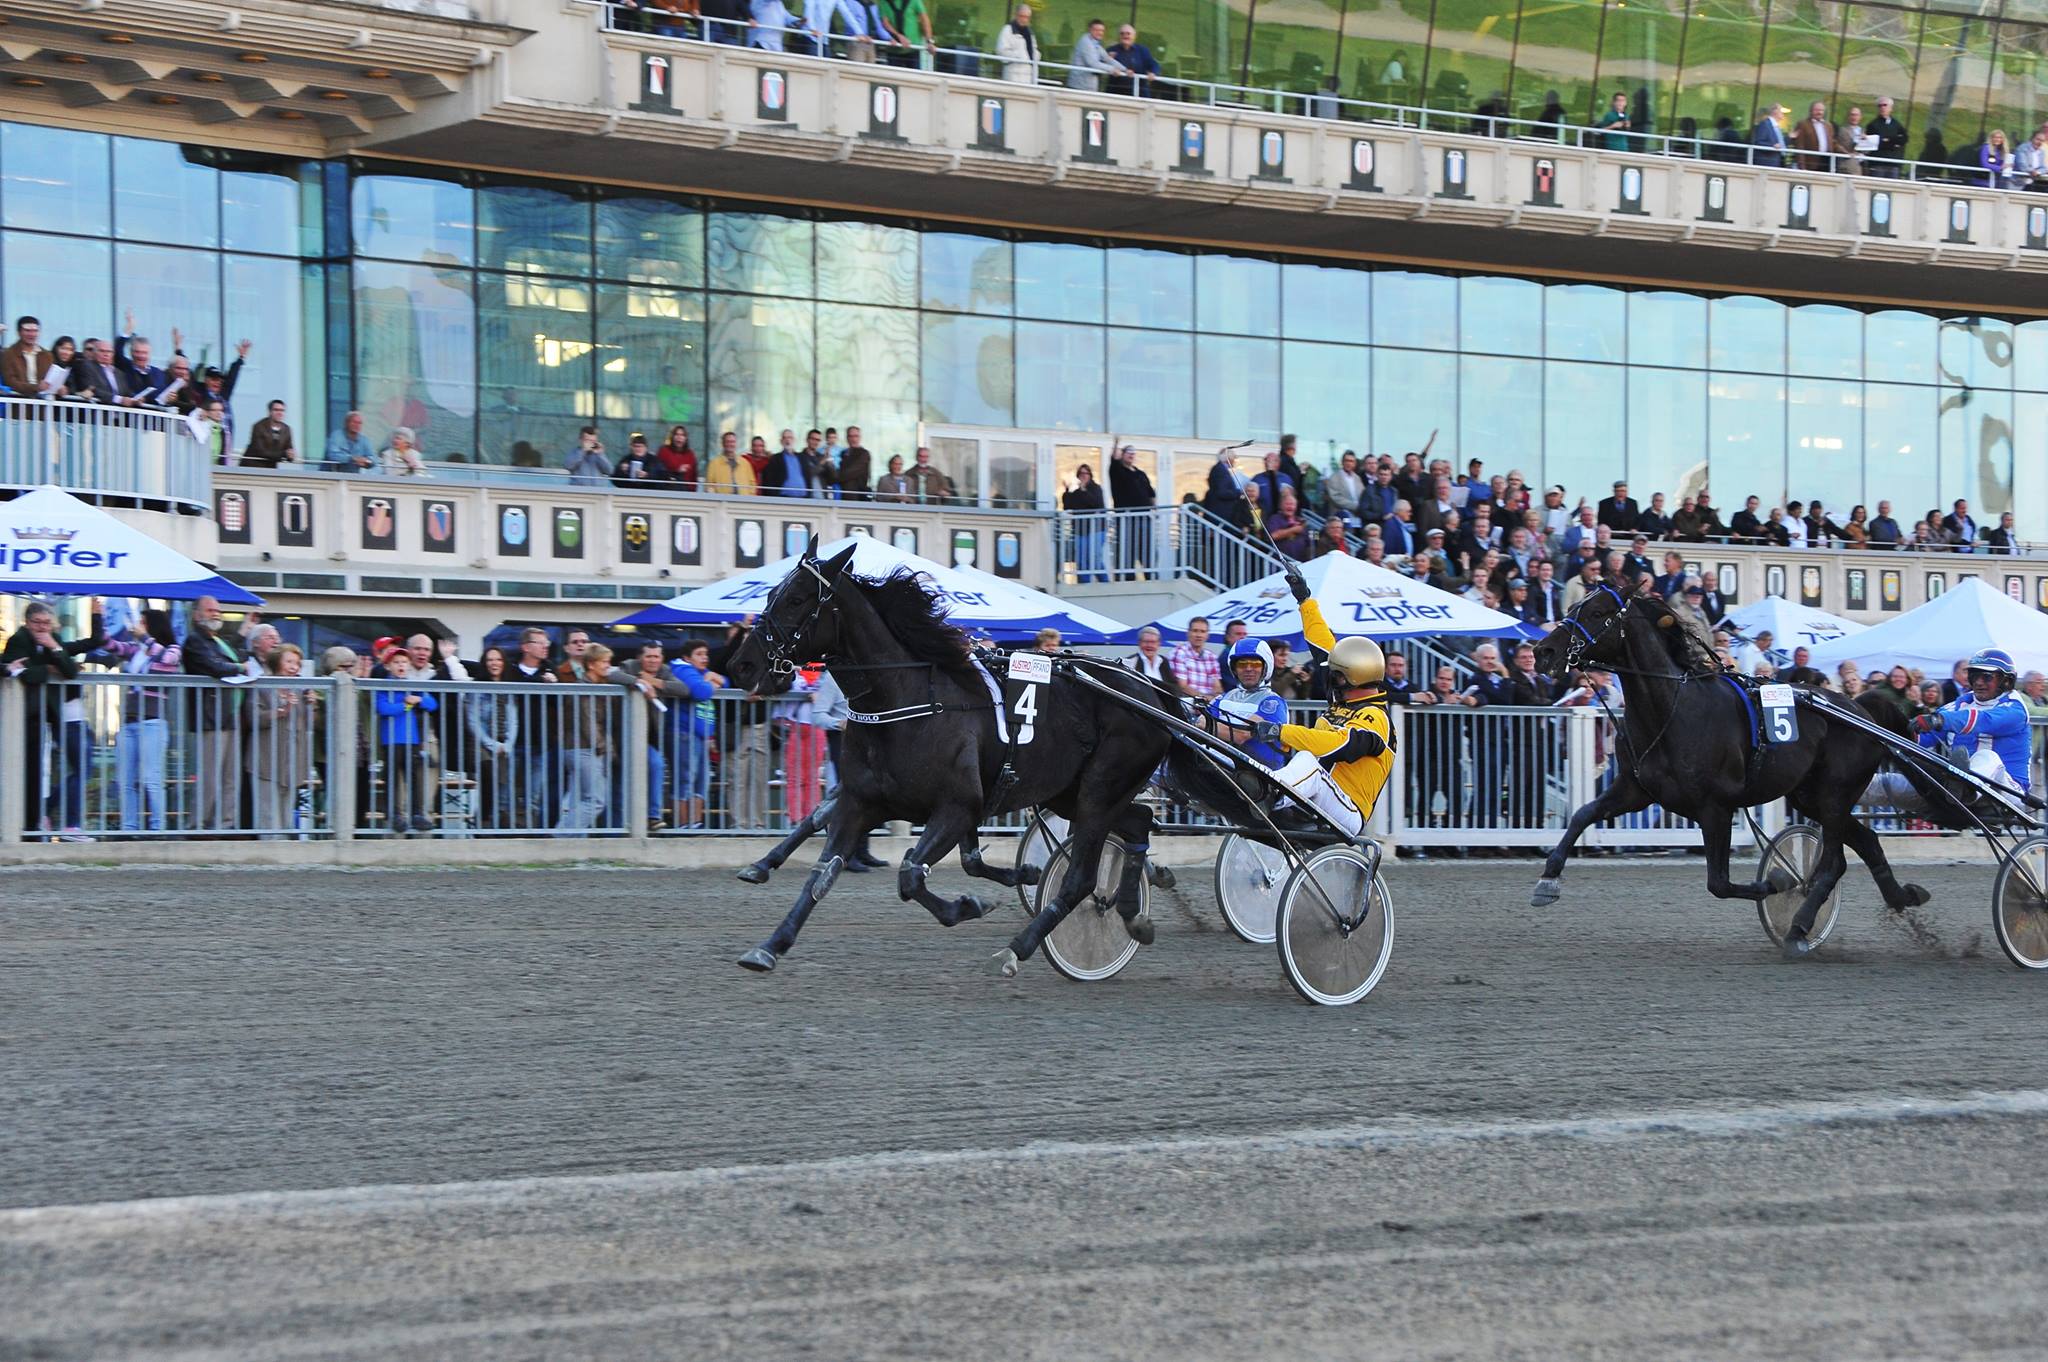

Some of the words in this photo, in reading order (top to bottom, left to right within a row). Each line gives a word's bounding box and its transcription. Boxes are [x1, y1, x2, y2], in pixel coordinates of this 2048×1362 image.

[0, 543, 129, 572] ipfer
[718, 581, 774, 605] Zip
[1208, 600, 1293, 625] Zipfer
[1341, 600, 1454, 626] Zipfer
[1011, 659, 1031, 671] AUSTRO
[1014, 683, 1038, 725] 4
[1773, 707, 1793, 742] 5
